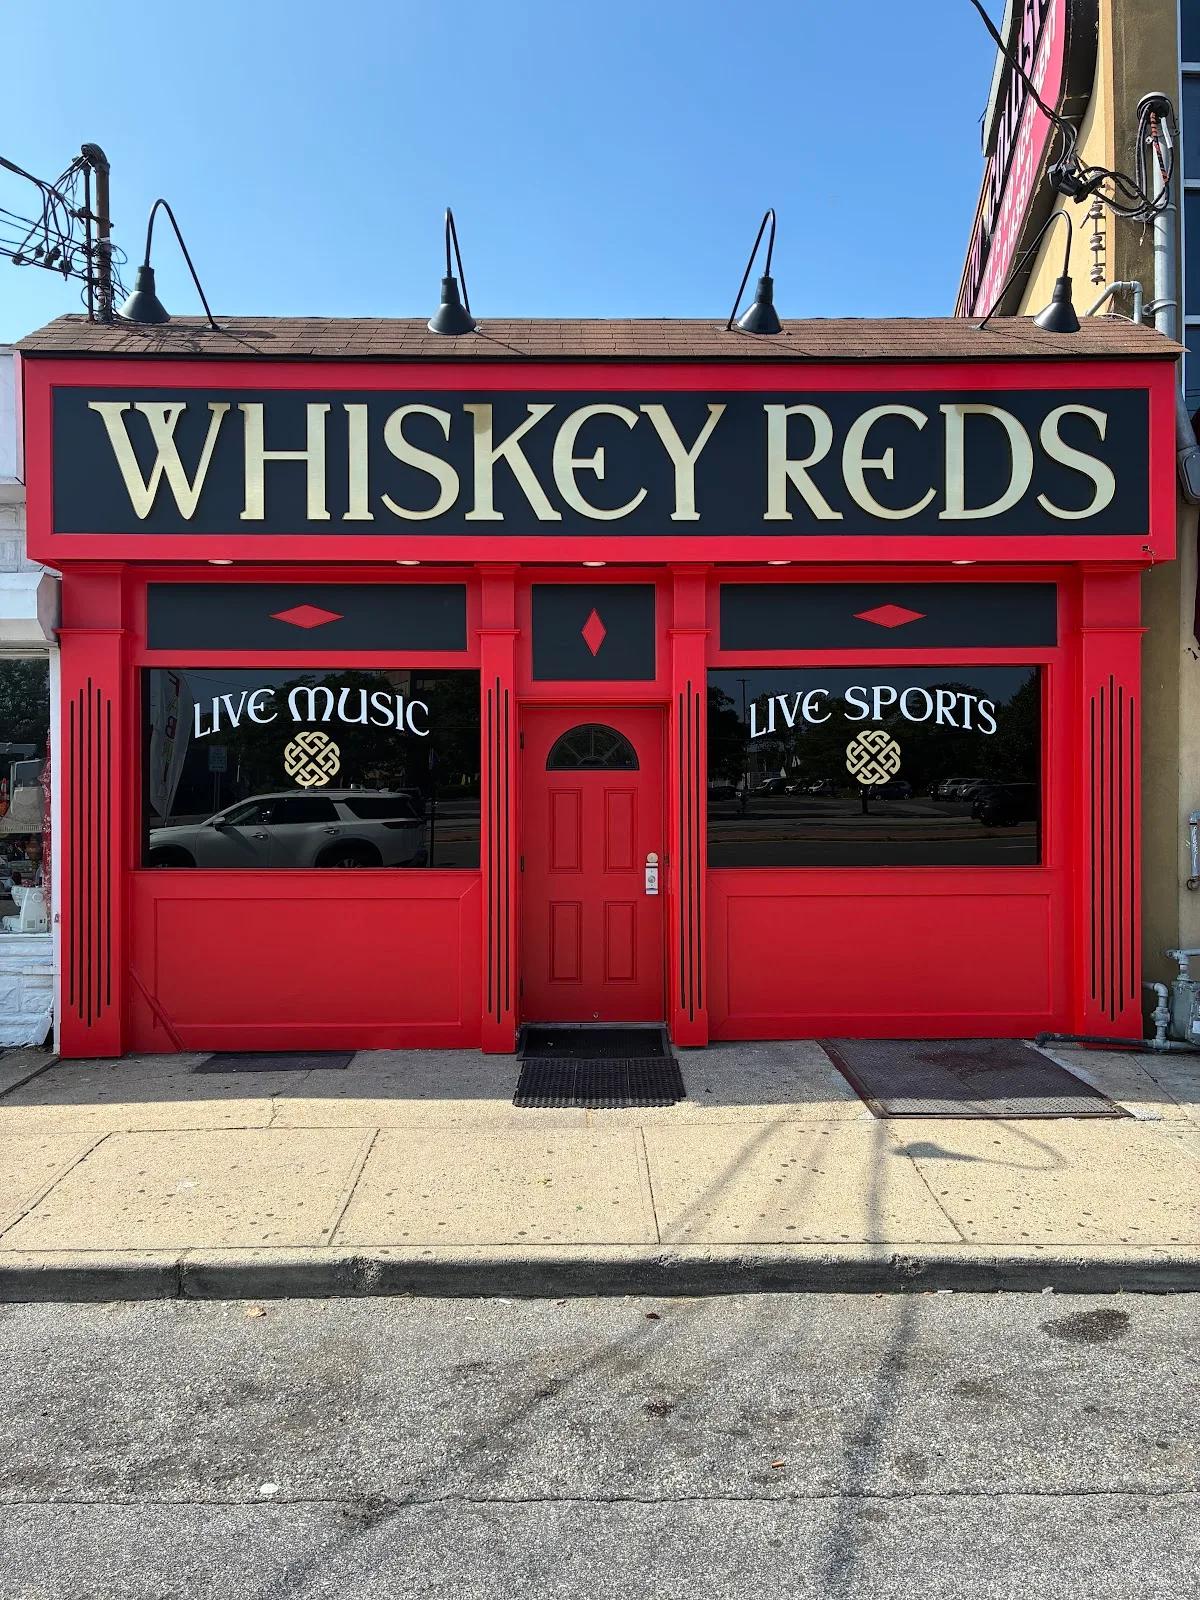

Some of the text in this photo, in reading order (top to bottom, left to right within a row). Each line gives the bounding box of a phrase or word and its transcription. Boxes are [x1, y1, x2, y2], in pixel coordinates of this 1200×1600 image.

[988, 0, 1046, 233] COLLISI
[88, 401, 1116, 521] WHISKEY REDS
[193, 686, 430, 739] LIVE MUSIC
[749, 685, 997, 739] LIVE SPORTS
